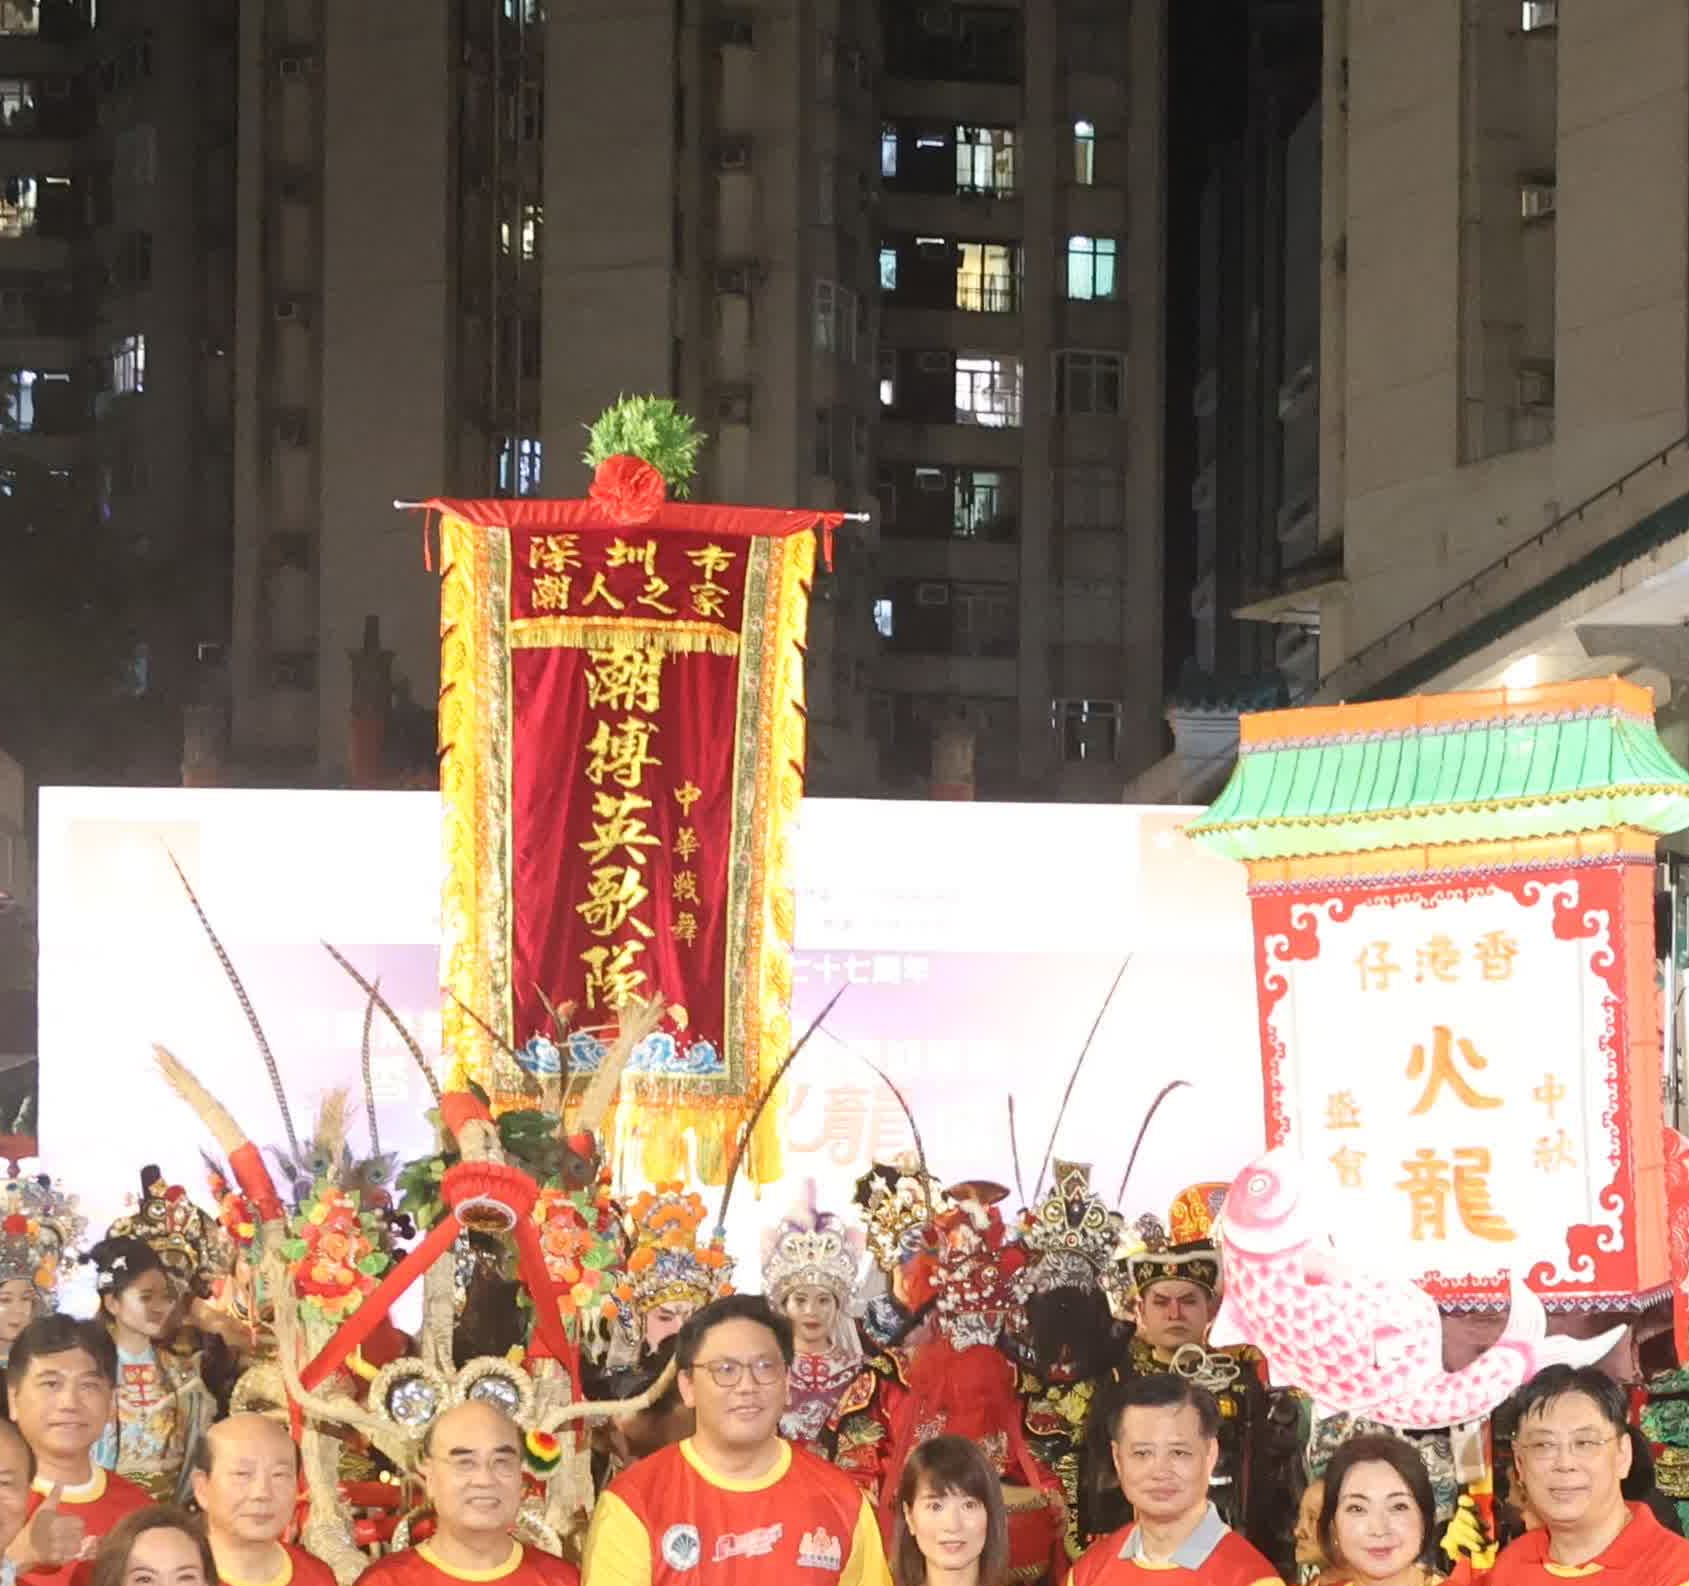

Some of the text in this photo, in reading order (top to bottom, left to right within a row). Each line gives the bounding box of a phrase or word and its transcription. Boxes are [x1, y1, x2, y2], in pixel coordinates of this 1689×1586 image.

[528, 534, 737, 580] 深圳市
[531, 571, 730, 618] 潮人之家
[1355, 929, 1519, 992] 香港仔
[1393, 1024, 1518, 1242] 火龍
[1532, 1072, 1577, 1174] 中秋
